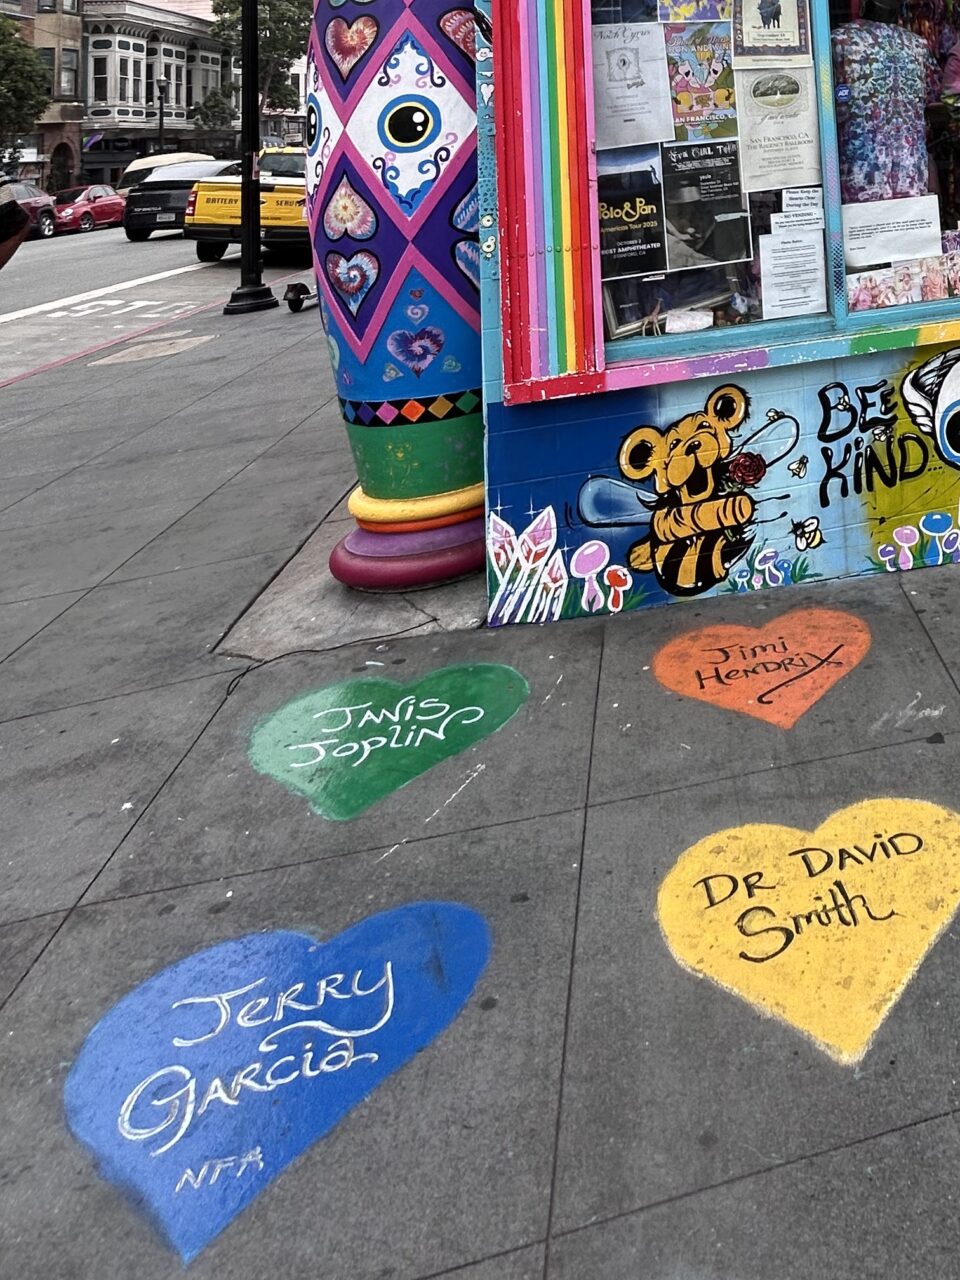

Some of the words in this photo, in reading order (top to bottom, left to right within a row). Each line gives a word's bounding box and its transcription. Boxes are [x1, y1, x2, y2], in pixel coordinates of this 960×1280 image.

[837, 89, 850, 97] ADT
[687, 113, 726, 122] FRANCISCO,
[205, 197, 239, 205] BATTERY
[702, 635, 790, 665] Jimi
[692, 868, 777, 910] DR
[737, 880, 896, 965] Smith
